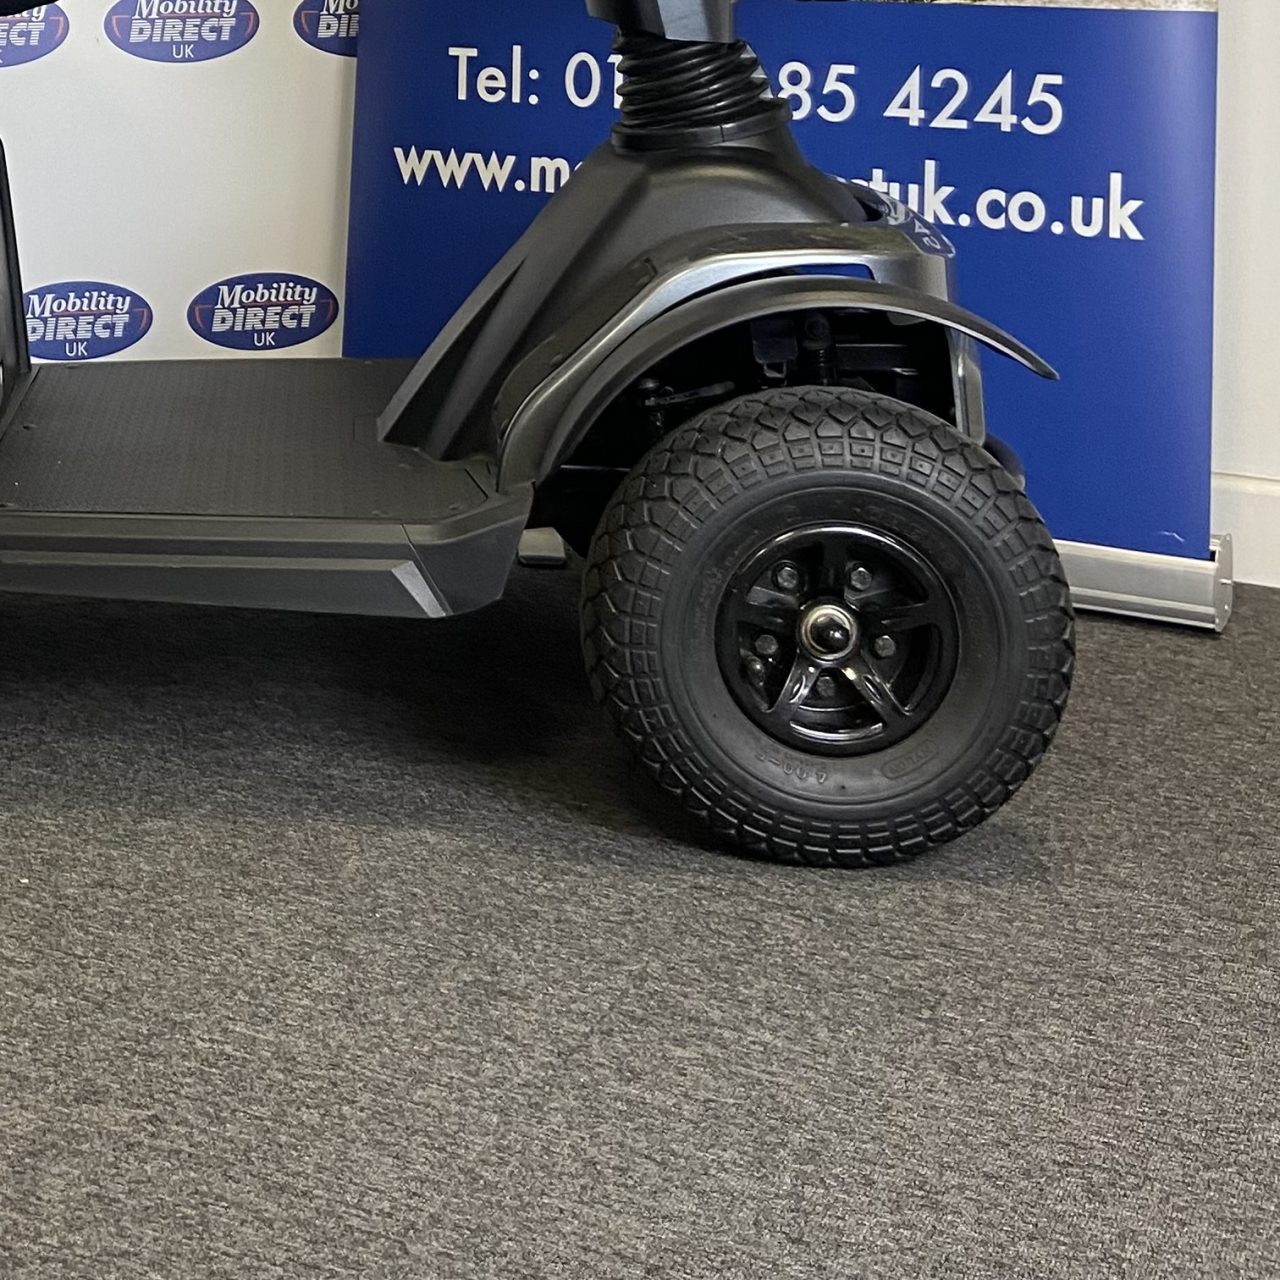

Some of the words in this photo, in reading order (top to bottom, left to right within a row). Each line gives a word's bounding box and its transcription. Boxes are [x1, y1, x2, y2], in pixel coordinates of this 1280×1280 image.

[129, 17, 236, 43] DIRECT
[173, 44, 194, 58] UK
[448, 45, 539, 105] Tel:
[883, 64, 1064, 135] 4245
[26, 291, 131, 318] Mobility
[214, 282, 318, 309] Mobility
[26, 314, 129, 341] DIRECT
[211, 304, 316, 332] DIRECT
[66, 341, 88, 356] UK
[254, 331, 275, 346] UK
